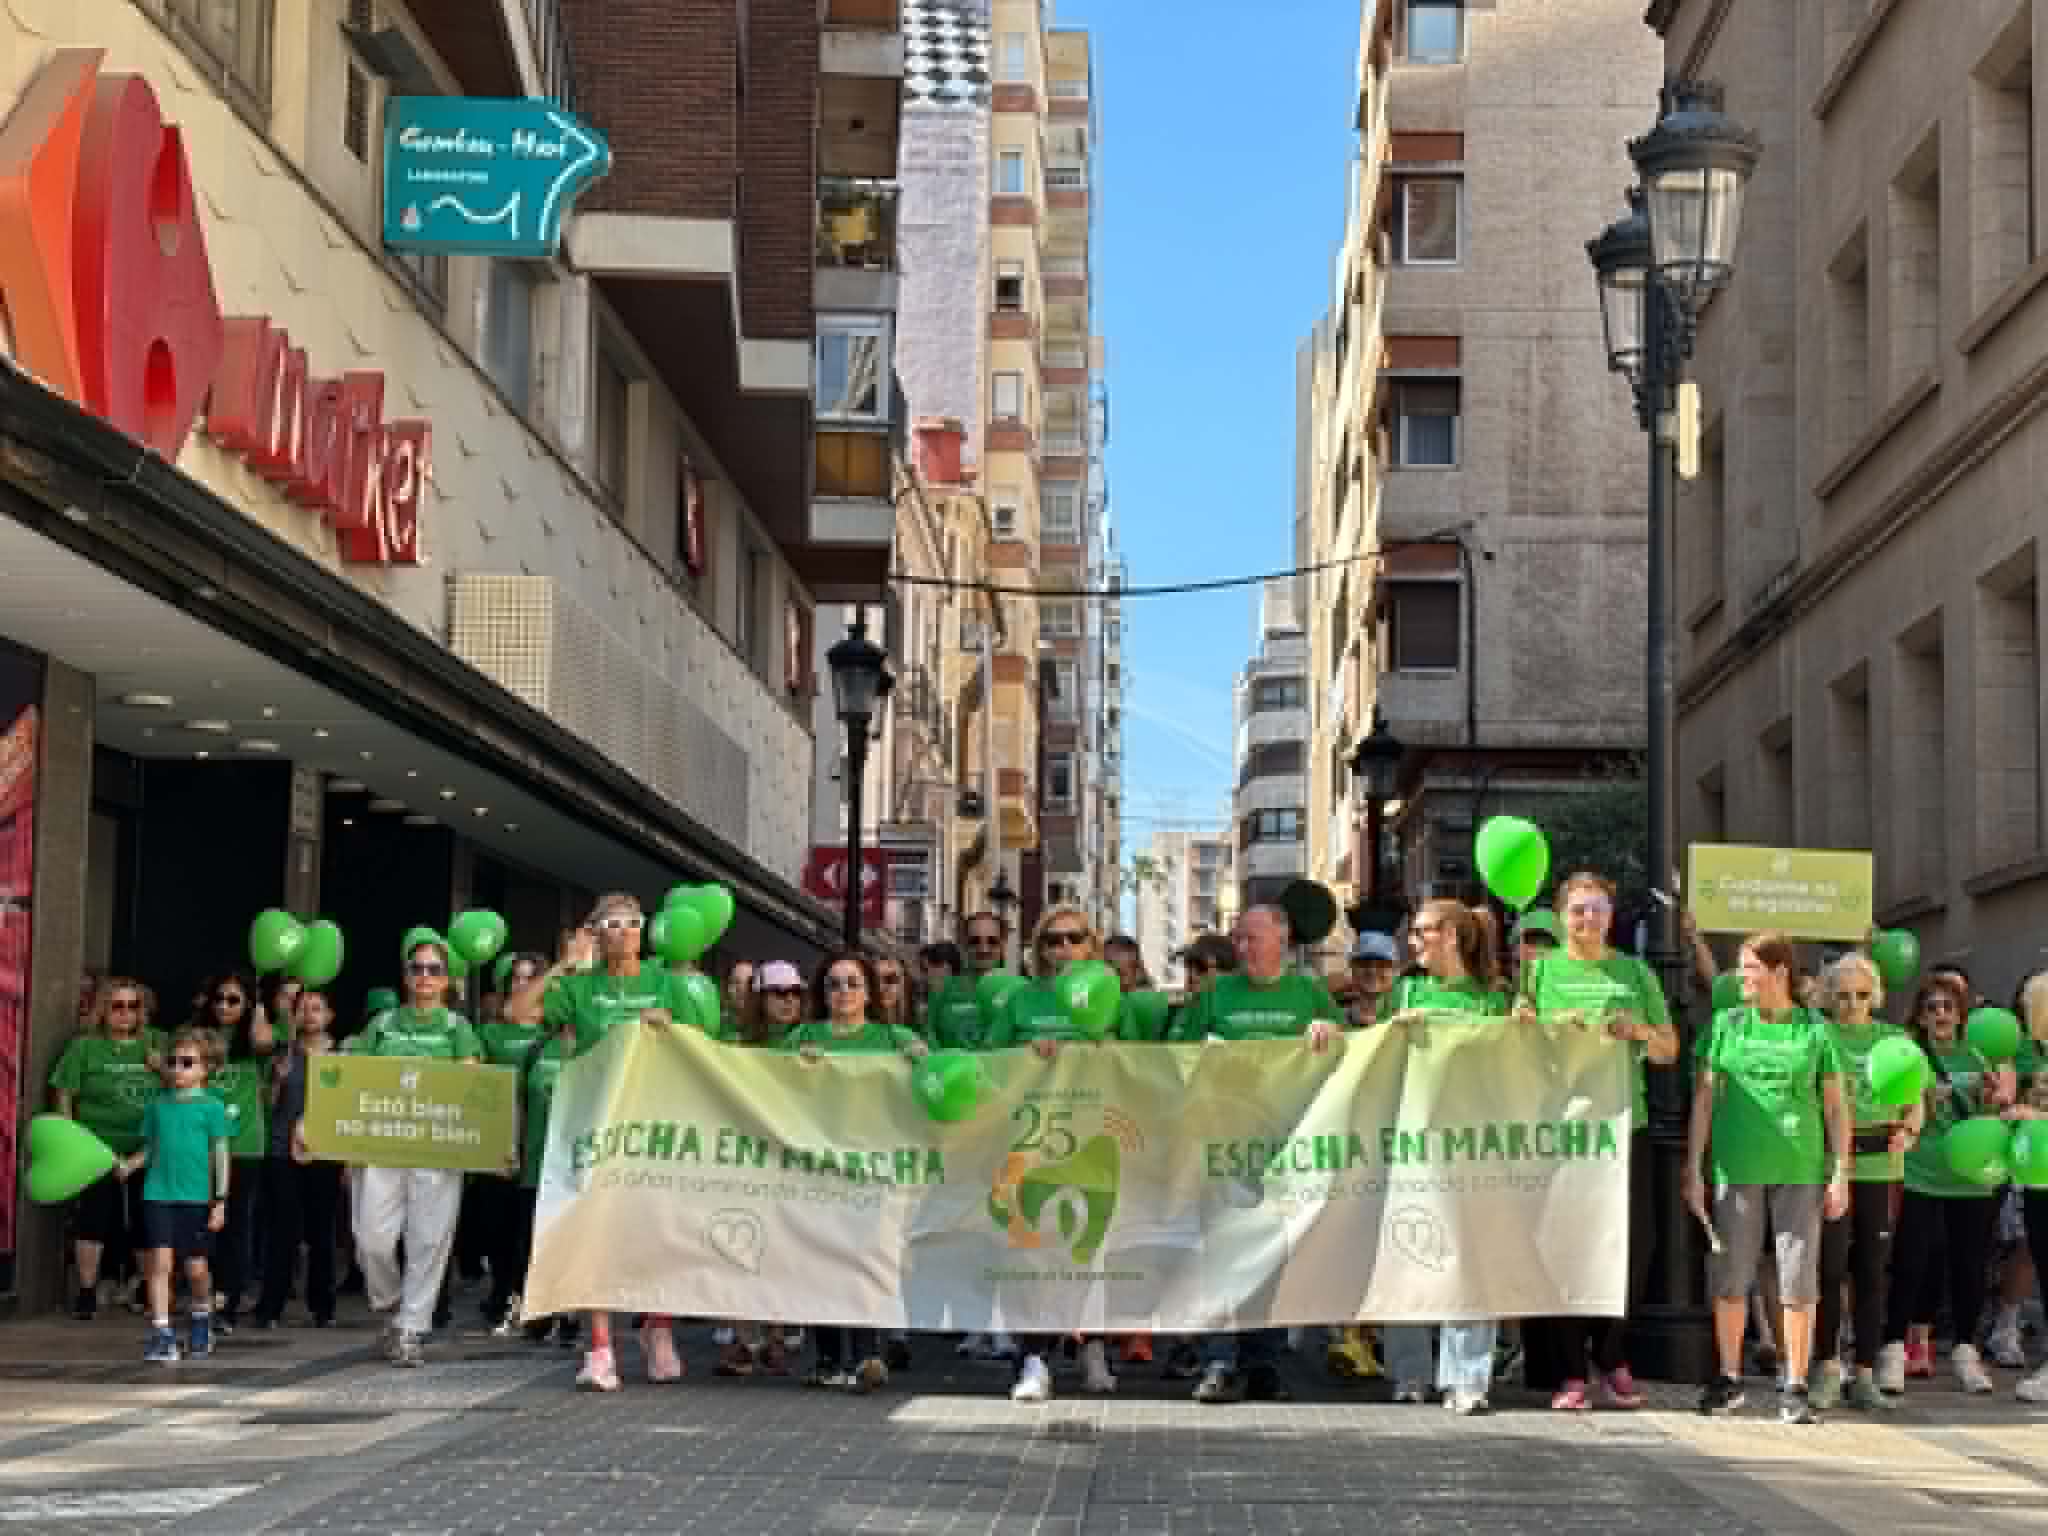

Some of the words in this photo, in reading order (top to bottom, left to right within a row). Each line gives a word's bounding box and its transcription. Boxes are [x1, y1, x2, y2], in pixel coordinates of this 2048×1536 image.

[335, 1118, 365, 1137] no
[715, 1127, 769, 1171] EN
[782, 1146, 944, 1185] MARCHA
[1011, 1103, 1078, 1160] 25
[1206, 1132, 1369, 1180] ESCUCHA
[1380, 1125, 1427, 1166] EN
[1441, 1119, 1618, 1162] MARCHA
